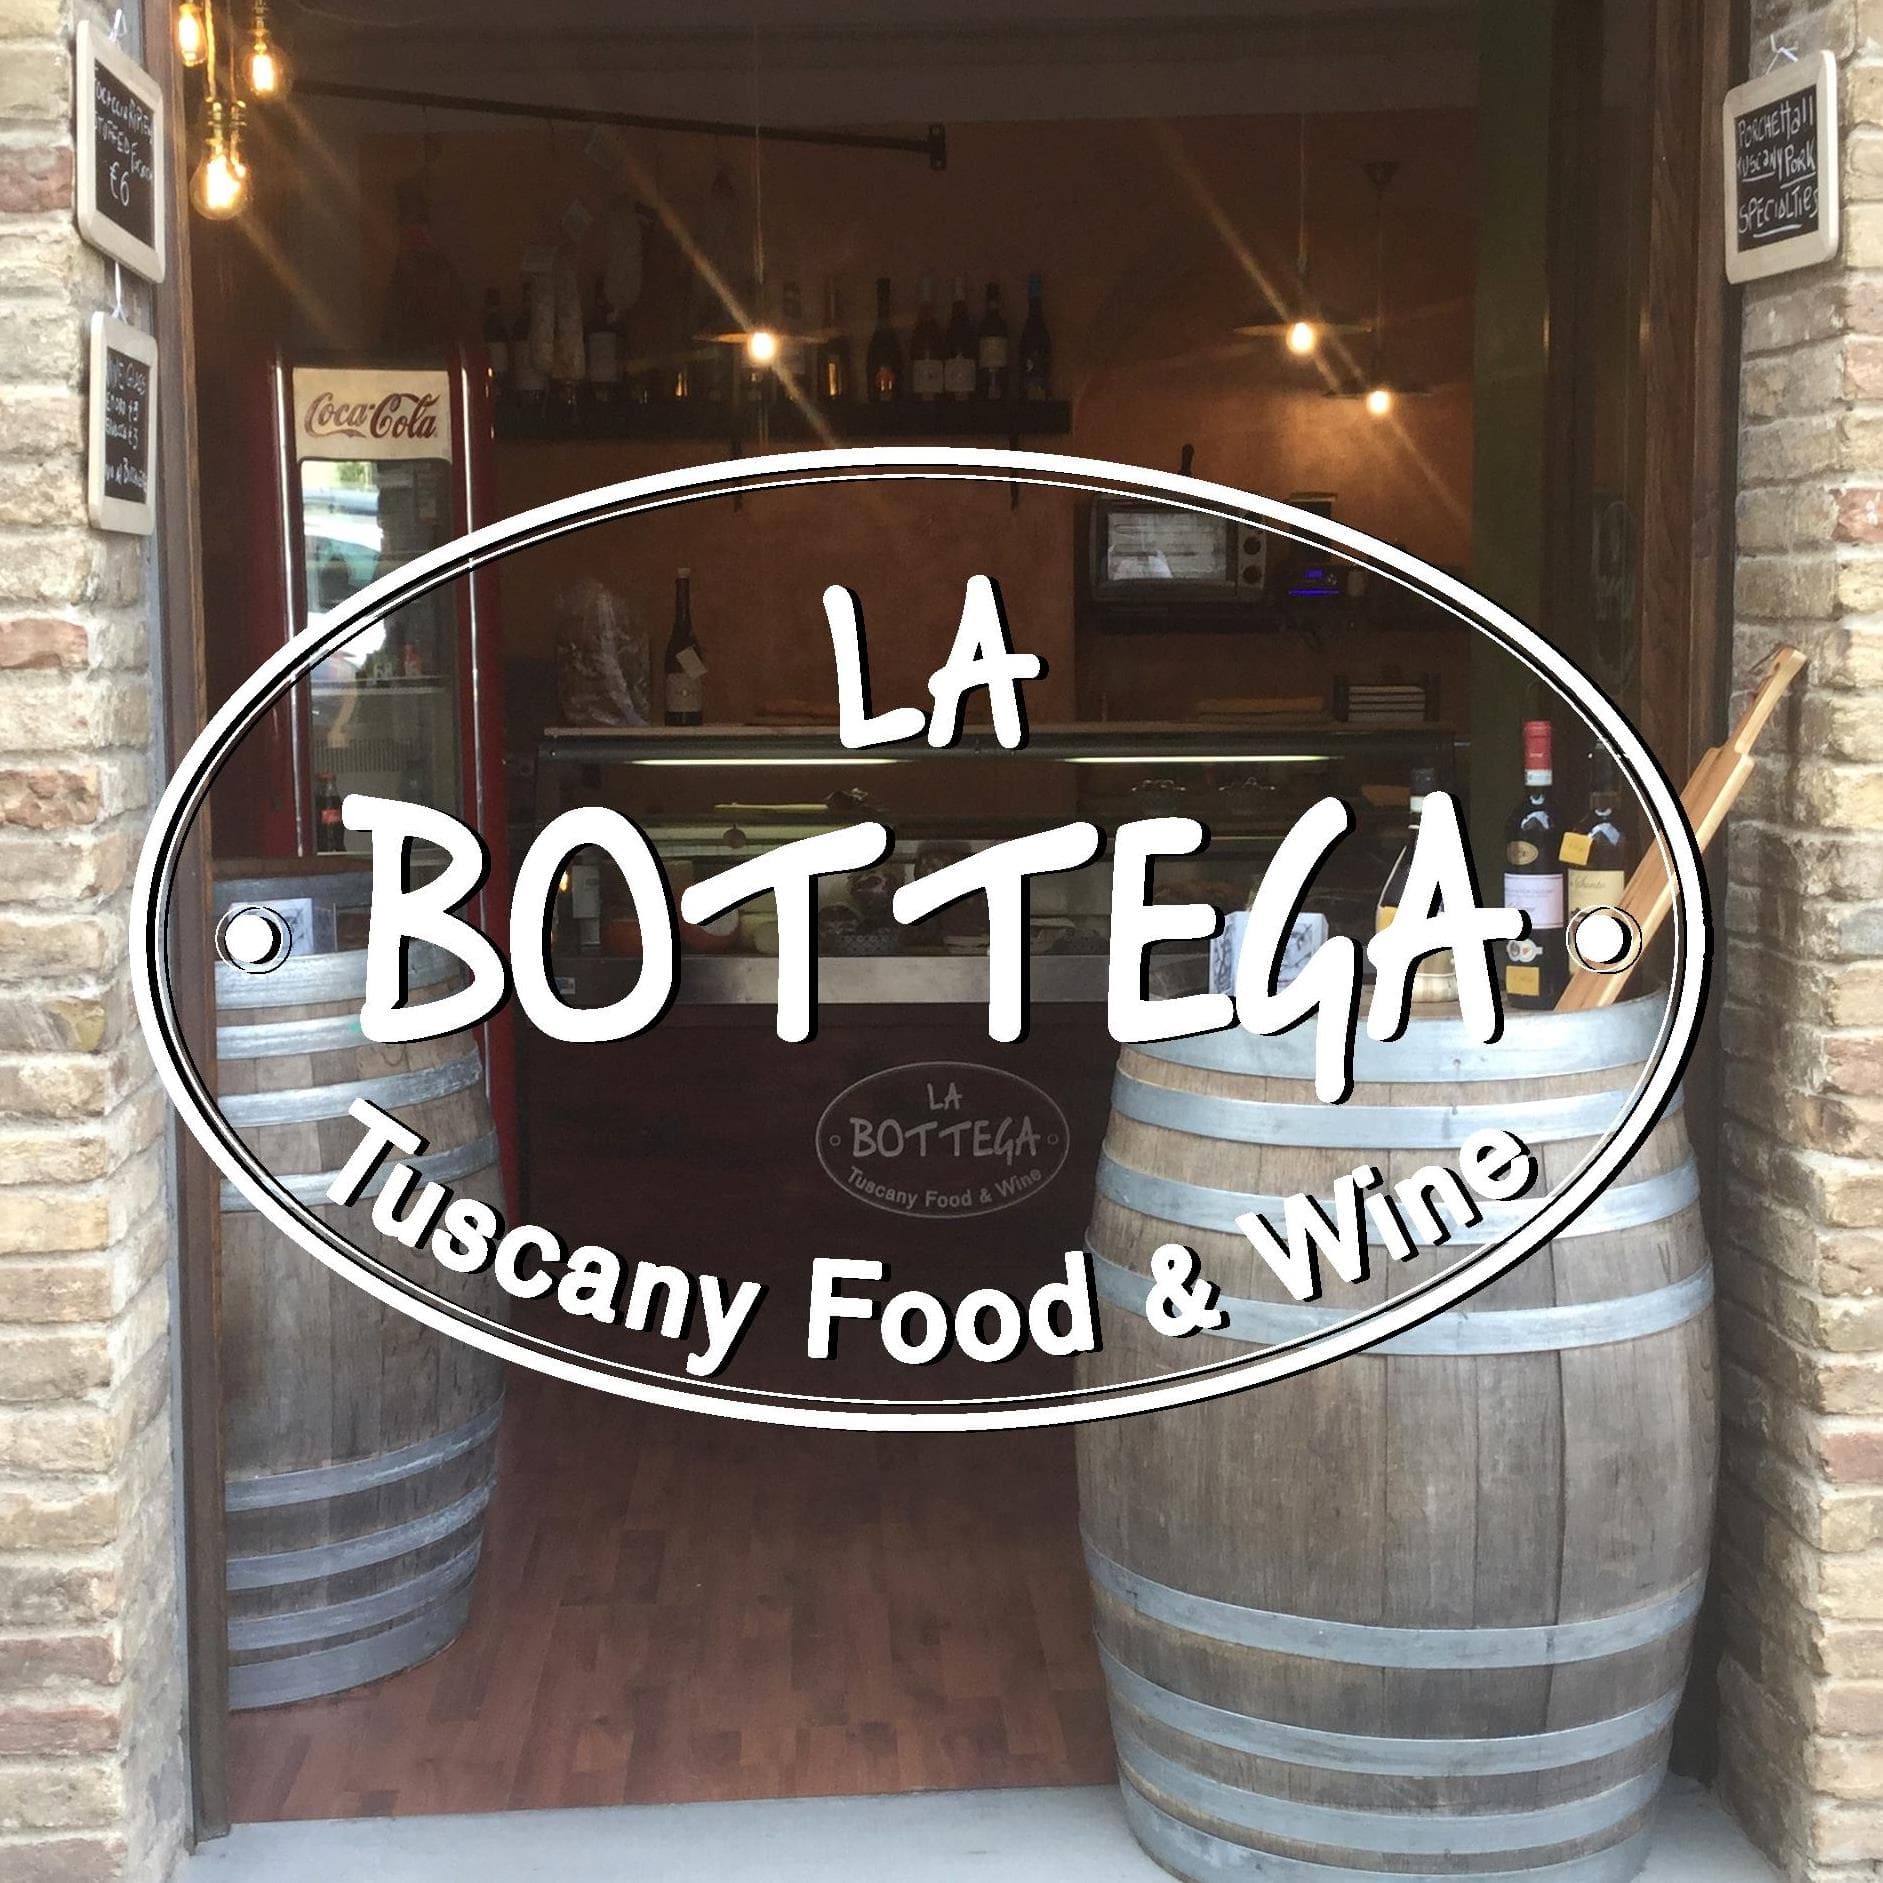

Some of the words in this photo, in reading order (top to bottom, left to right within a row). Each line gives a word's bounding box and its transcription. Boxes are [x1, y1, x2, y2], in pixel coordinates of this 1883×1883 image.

[109, 161, 130, 207] €6
[304, 391, 441, 439] Coca-Cola
[927, 1082, 963, 1110] LA
[850, 1115, 1041, 1166] BOTTEGA
[848, 1166, 918, 1209] Tuscany
[925, 1189, 972, 1208] Food
[979, 1187, 993, 1203] &
[995, 1168, 1042, 1198] Wine
